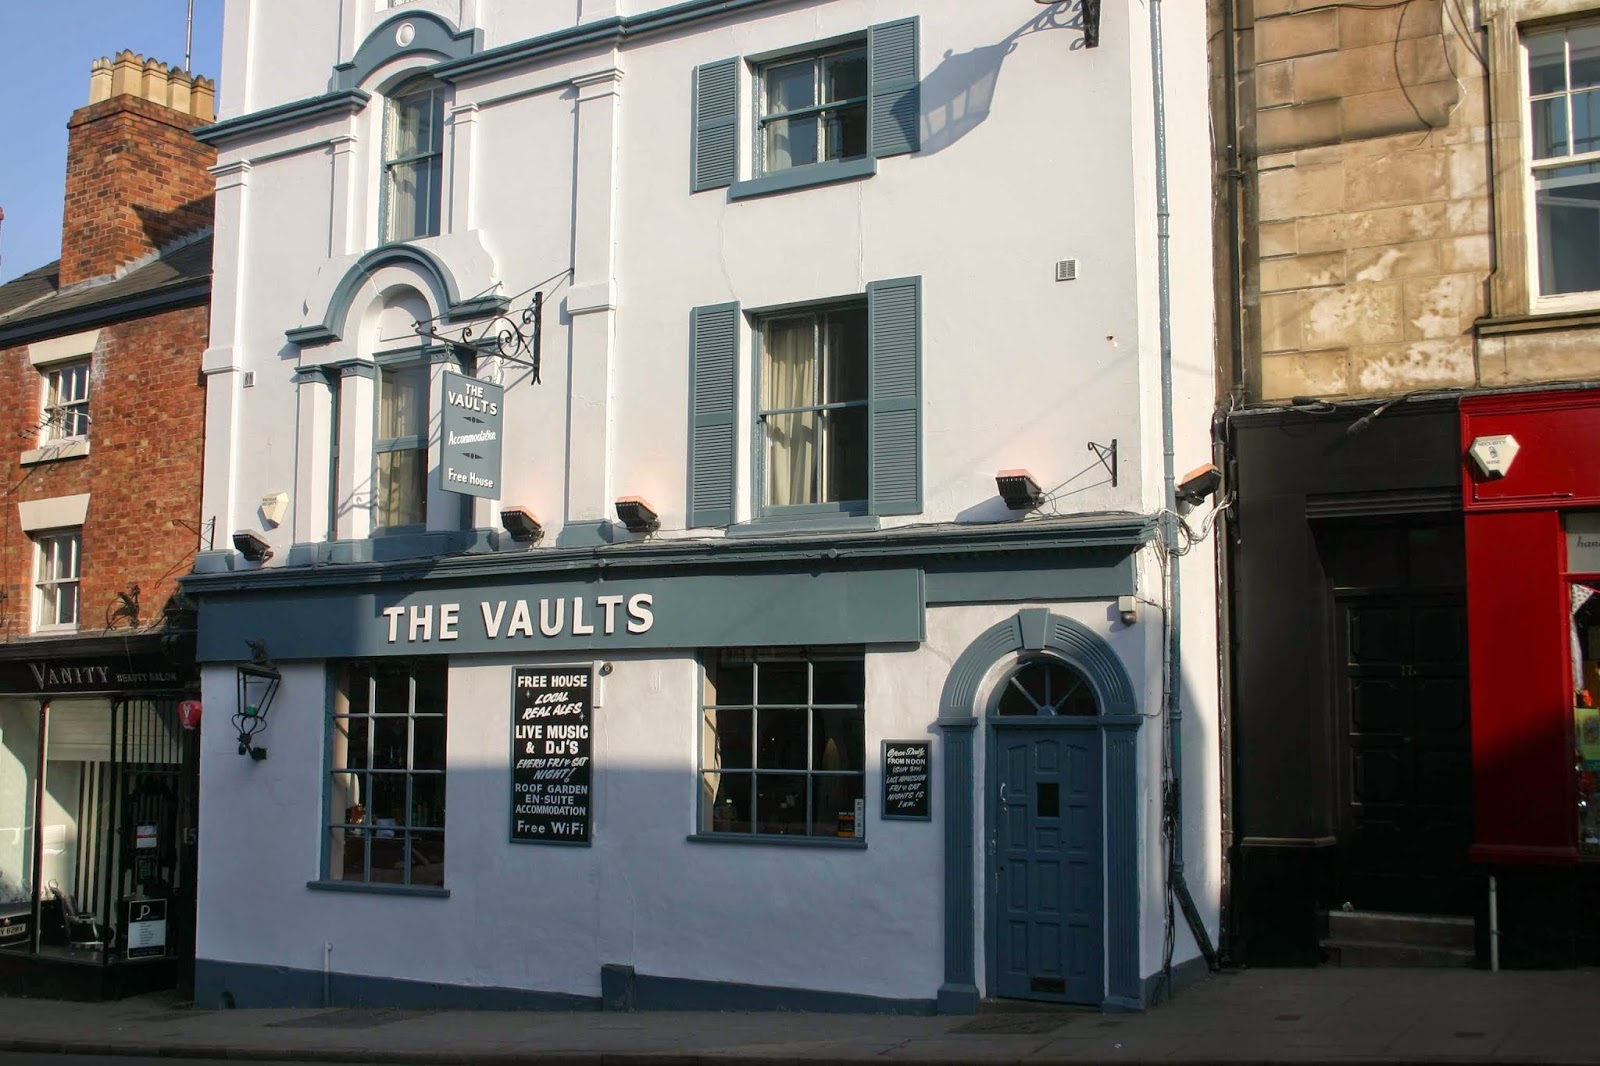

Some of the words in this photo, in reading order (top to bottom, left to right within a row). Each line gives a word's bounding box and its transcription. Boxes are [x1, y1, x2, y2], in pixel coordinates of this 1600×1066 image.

[465, 383, 484, 398] THE
[448, 390, 498, 416] VAULTS
[448, 429, 497, 446] Accommodation
[448, 467, 468, 483] Free
[469, 472, 494, 488] House
[383, 602, 460, 642] THE
[480, 593, 655, 638] VAULTS
[28, 662, 109, 691] VANITY
[116, 673, 148, 682] BEAUTY
[150, 672, 177, 681] SALON
[517, 675, 547, 688] FREE
[551, 675, 588, 688] HOUSE
[535, 691, 569, 705] LOCAL
[522, 706, 552, 721] REAL
[552, 702, 583, 716] ALES
[515, 725, 543, 739] LIVE
[547, 725, 589, 739] MUSIC
[525, 741, 535, 754] &
[545, 739, 579, 755] DJ'S
[516, 758, 546, 769] EVERY
[546, 758, 563, 768] FRI
[571, 757, 589, 767] SAT
[533, 767, 577, 783] NIGHT!
[515, 783, 543, 793] ROOF
[547, 784, 588, 794] GARDEN
[515, 804, 586, 816] ACCOMMODATION
[517, 820, 546, 833] Free
[550, 821, 584, 835] WiFi
